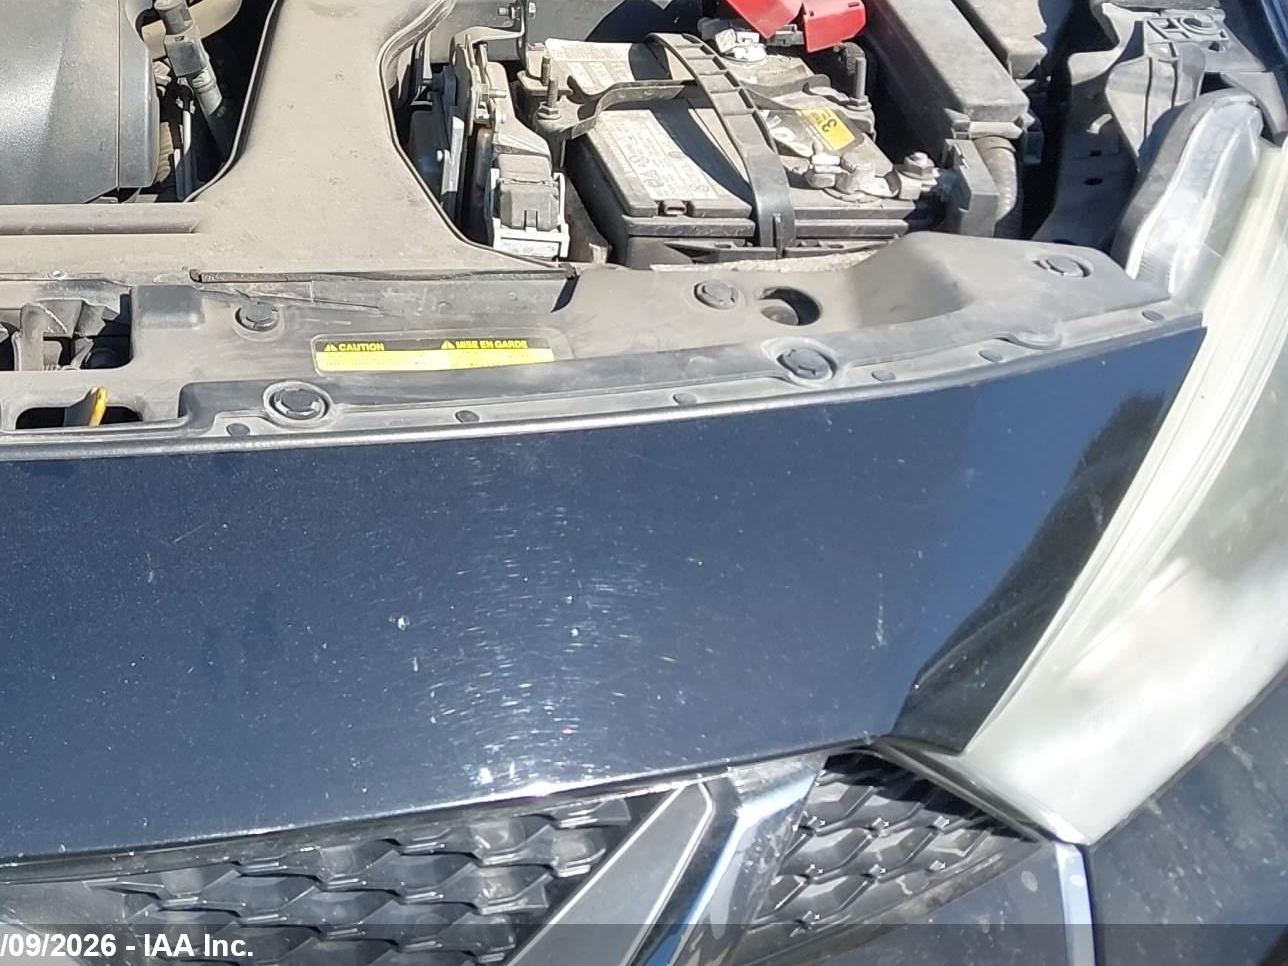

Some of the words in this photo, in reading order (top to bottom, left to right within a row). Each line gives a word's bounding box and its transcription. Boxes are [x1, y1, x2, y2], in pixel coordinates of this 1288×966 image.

[338, 342, 385, 352] CAUTION
[455, 339, 479, 349] MISE
[480, 339, 494, 349] EN
[495, 339, 529, 349] GARDE
